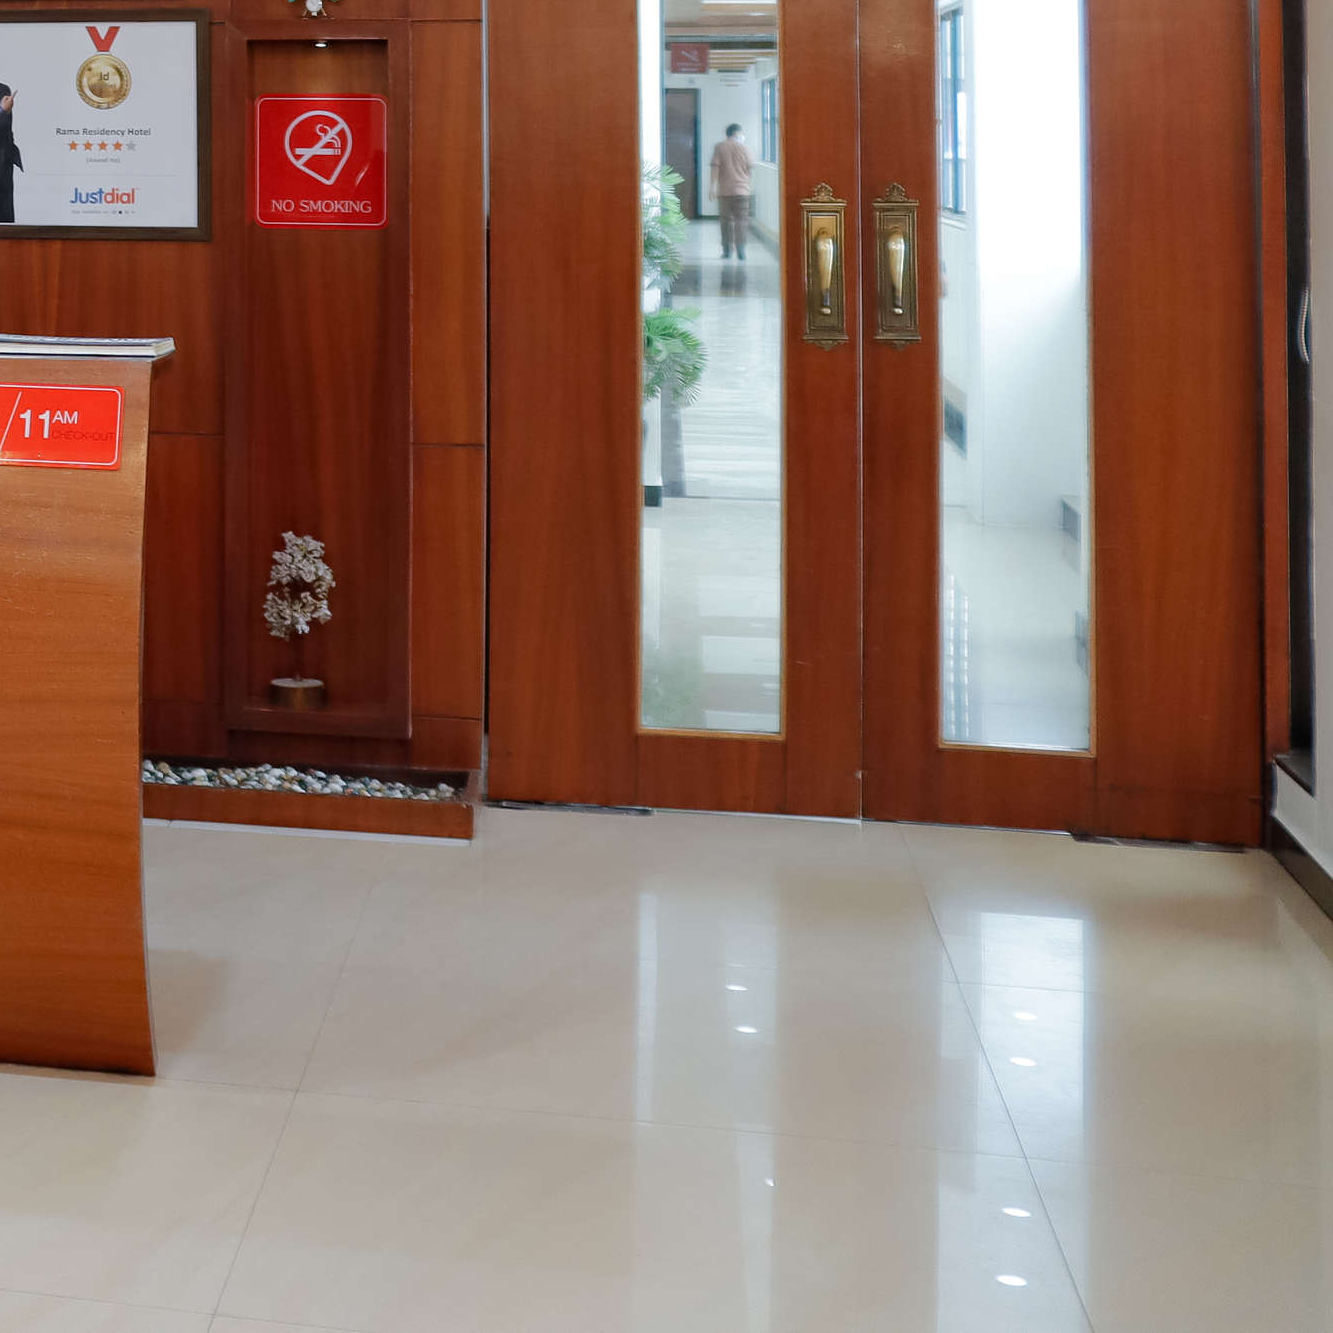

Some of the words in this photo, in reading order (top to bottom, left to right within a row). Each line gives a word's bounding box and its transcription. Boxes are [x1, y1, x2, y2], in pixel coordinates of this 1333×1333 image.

[55, 127, 80, 136] Rama
[82, 127, 125, 138] Residency
[127, 127, 151, 136] Hotel
[69, 187, 136, 204] Justdial
[271, 199, 294, 213] NO
[299, 199, 372, 213] SMOKING
